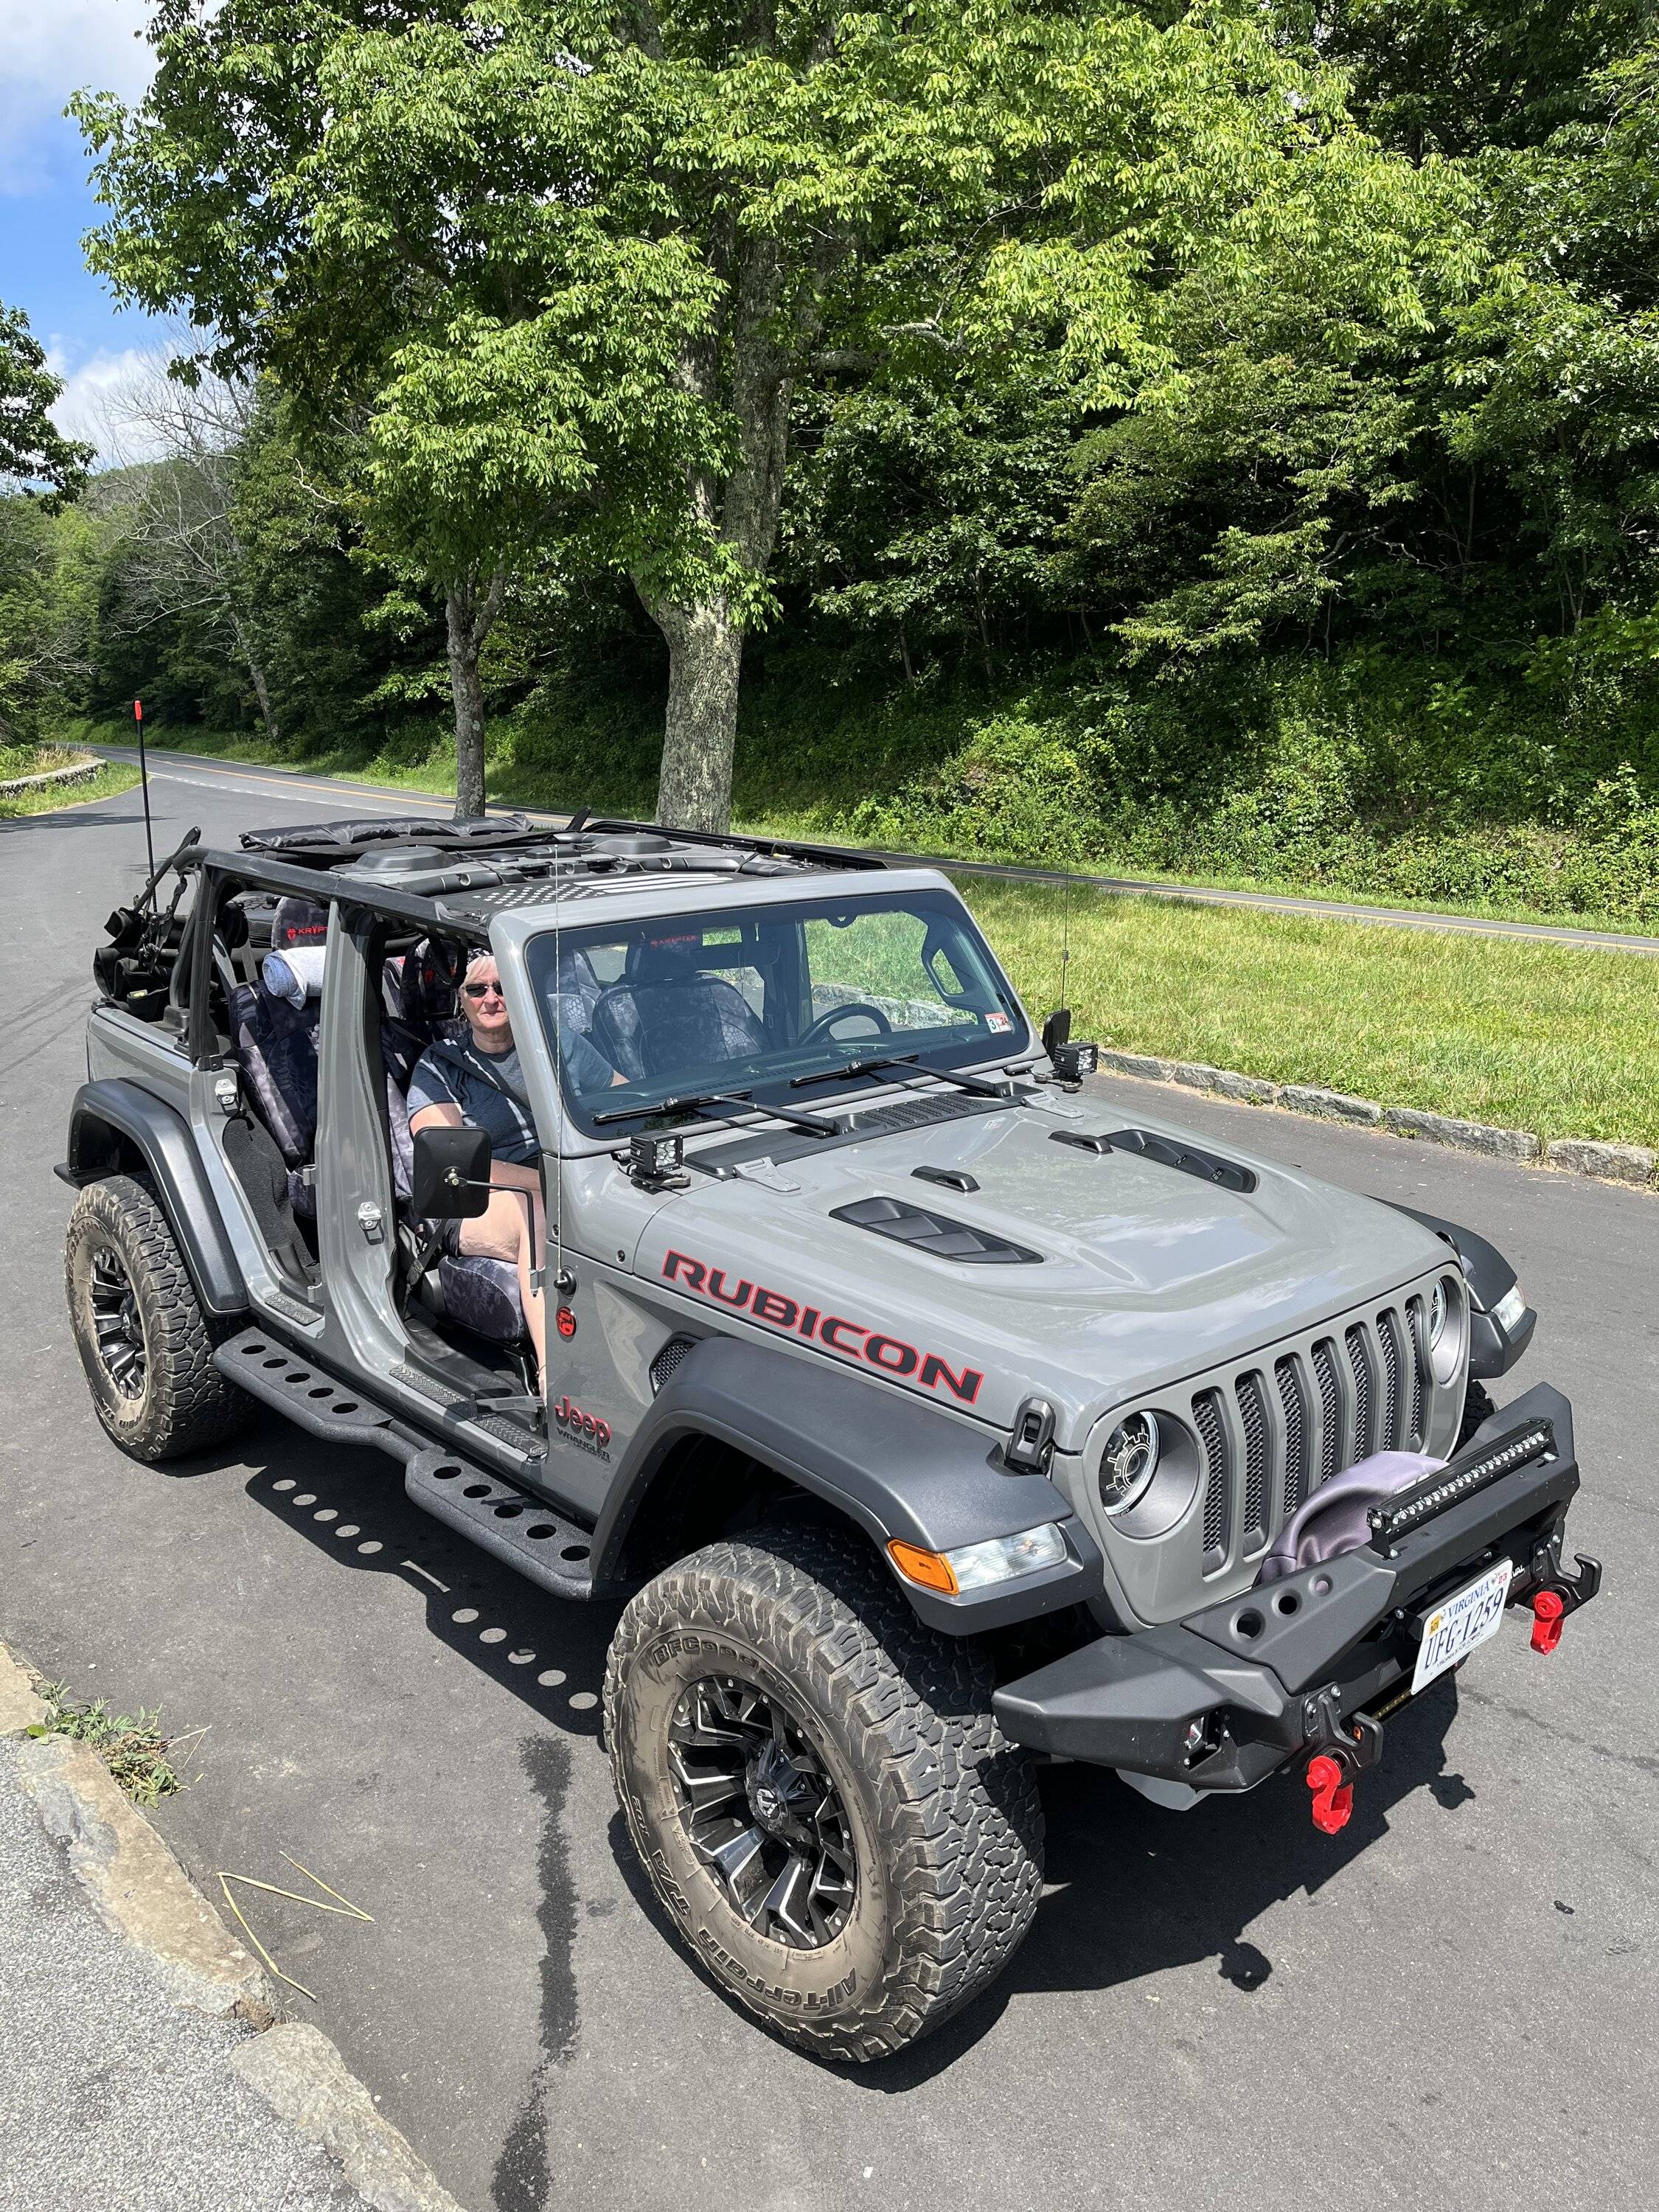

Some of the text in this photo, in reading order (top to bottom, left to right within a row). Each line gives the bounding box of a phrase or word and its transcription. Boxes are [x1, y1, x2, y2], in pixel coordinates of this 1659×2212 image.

[989, 1019, 997, 1029] 3
[661, 1249, 985, 1405] RUBICON
[554, 1394, 612, 1450] Jeep
[557, 1427, 611, 1459] WRANGLER
[1425, 1587, 1503, 1669] UFG-1259
[1449, 1581, 1489, 1617] VIRGINIA
[653, 1636, 824, 1741] BFGoodrich
[698, 1927, 857, 2011] All-Terrain
